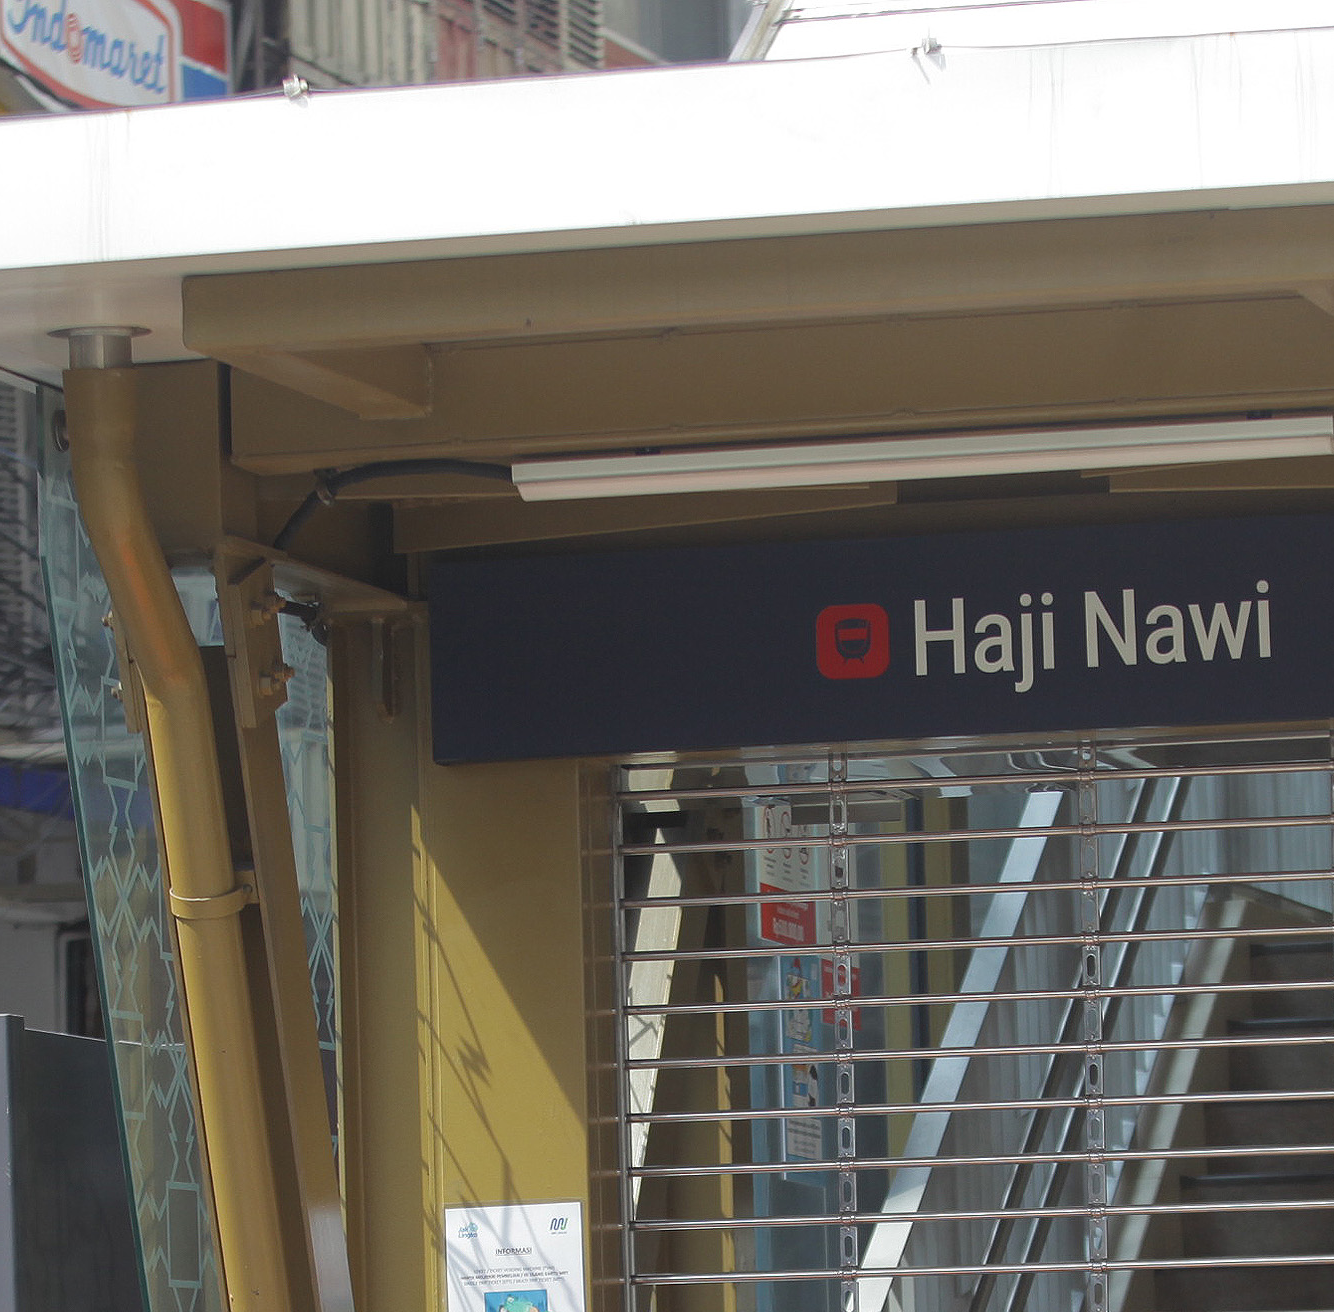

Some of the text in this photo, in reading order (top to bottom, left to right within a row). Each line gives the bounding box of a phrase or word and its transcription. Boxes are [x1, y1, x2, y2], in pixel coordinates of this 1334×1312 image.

[7, 0, 166, 93] Indomaret
[913, 579, 1273, 694] Haji Nawi
[495, 1247, 533, 1256] INFORMASI
